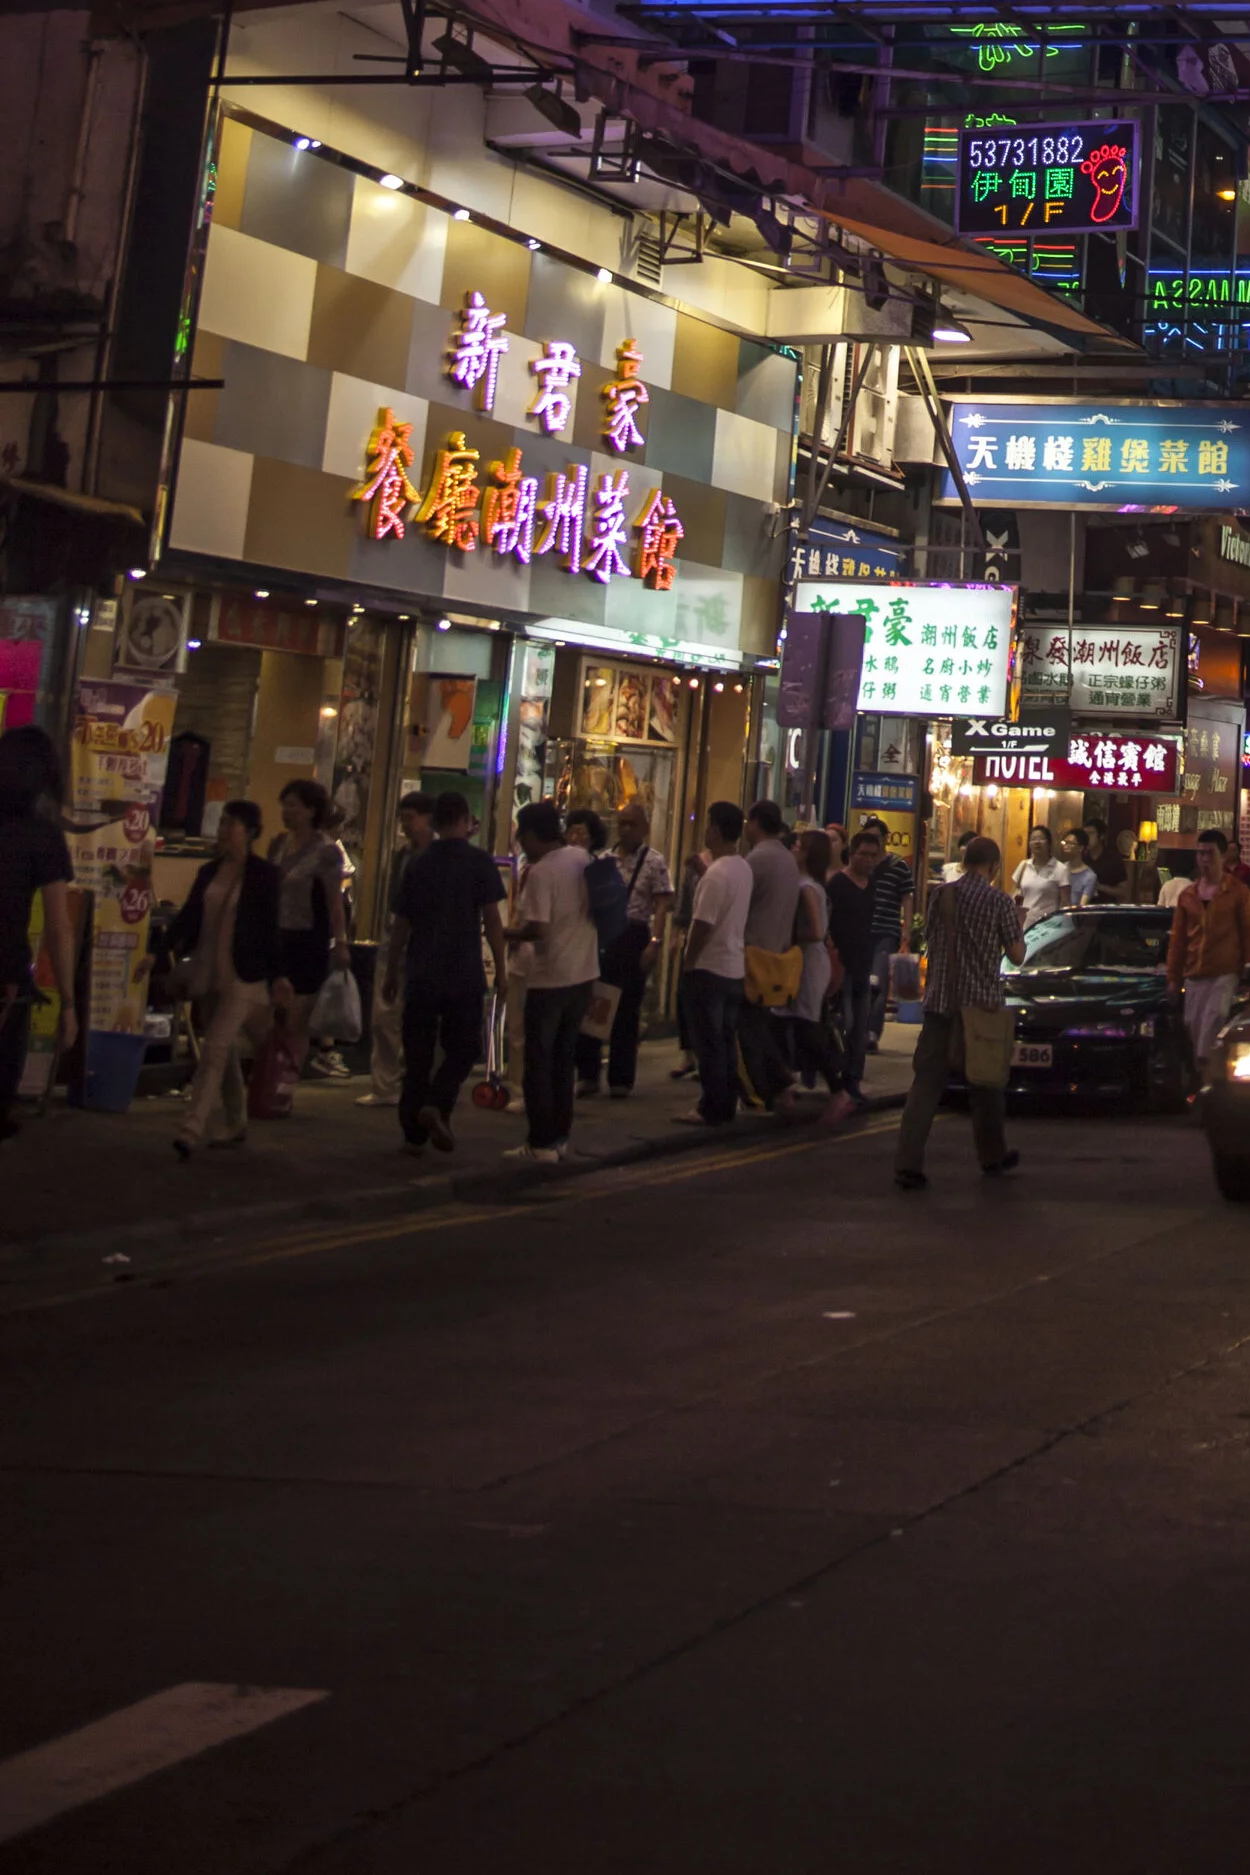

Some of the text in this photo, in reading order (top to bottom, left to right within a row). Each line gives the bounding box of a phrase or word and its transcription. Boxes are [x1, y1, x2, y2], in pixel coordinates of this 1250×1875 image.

[969, 135, 1084, 167] 53731882
[970, 167, 1075, 203] 伊甸園
[993, 201, 1066, 226] 1/F
[451, 290, 651, 453] 新君豪
[966, 435, 1230, 476] 天機棧雞煲菜館
[354, 406, 684, 592] 餐廳潮州菜館
[920, 623, 999, 650] 潮州飯店
[920, 683, 992, 704] 通宵營業
[965, 719, 1057, 737] X Game
[1002, 740, 1017, 749] 1/F
[1067, 739, 1168, 772] 誠信賓館
